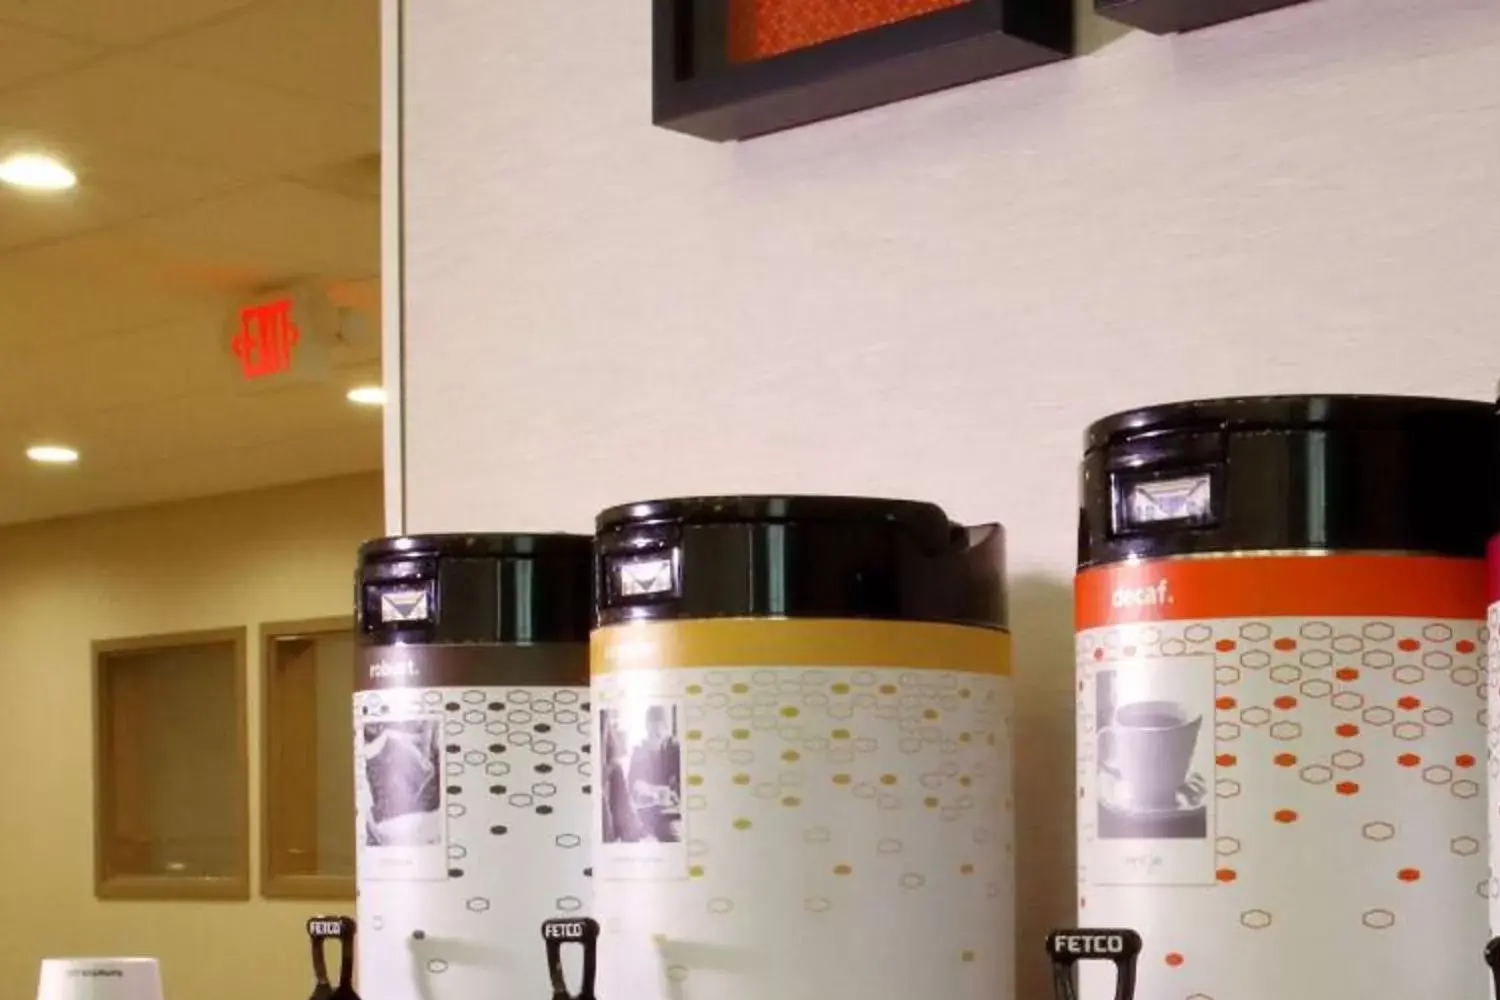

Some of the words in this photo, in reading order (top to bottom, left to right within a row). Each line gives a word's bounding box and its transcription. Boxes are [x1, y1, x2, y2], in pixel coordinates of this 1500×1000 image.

[240, 299, 292, 379] EXIT
[1112, 579, 1174, 607] decaf.
[310, 921, 340, 935] FETCO
[545, 922, 583, 938] FETCO
[1055, 935, 1123, 953] FETCO
